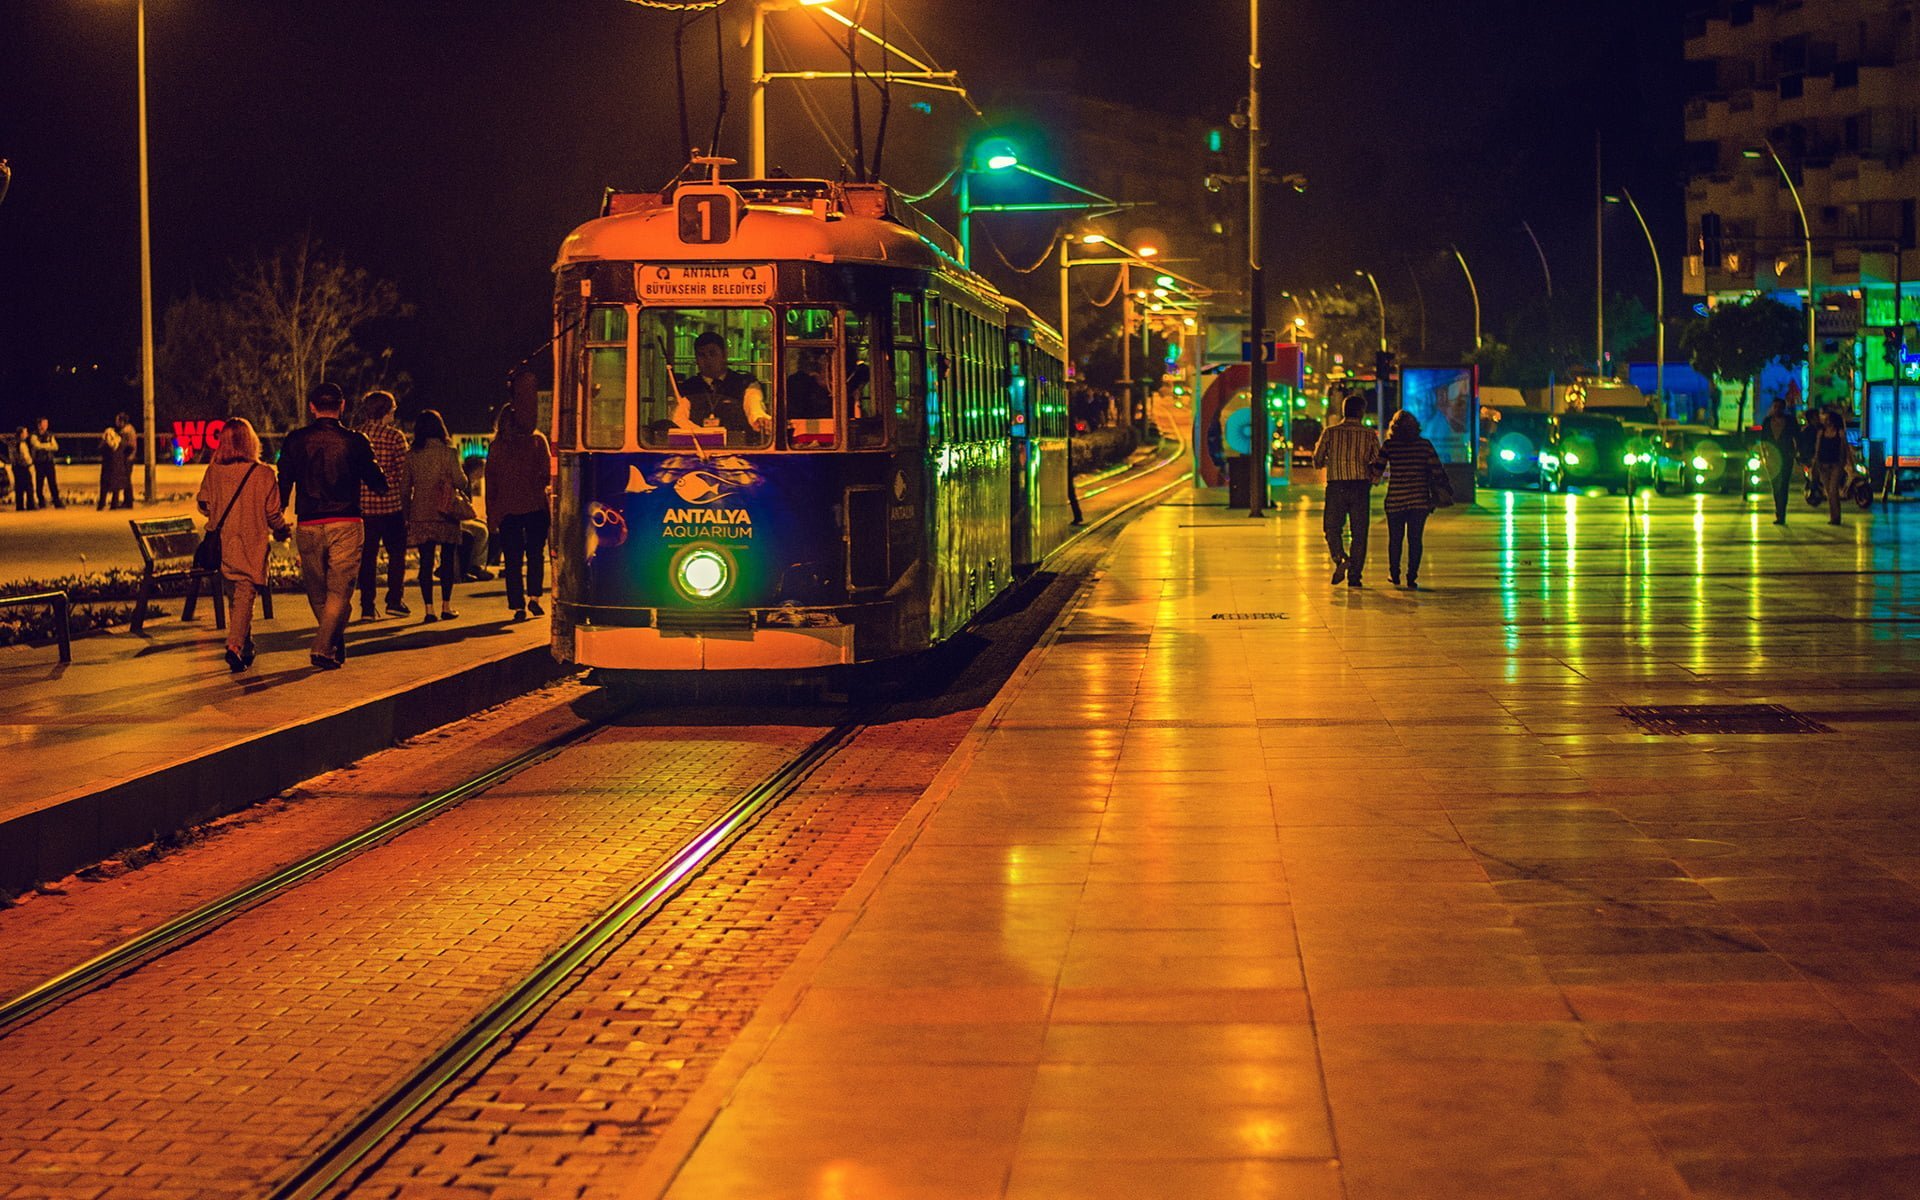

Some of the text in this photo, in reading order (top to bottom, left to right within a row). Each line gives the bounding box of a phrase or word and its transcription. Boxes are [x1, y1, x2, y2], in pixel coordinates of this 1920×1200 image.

[697, 201, 711, 241] 1
[683, 267, 729, 278] ANTALYA
[712, 281, 767, 294] BELEDİYESİ
[662, 508, 752, 525] ANTALYA
[662, 526, 753, 539] AQUARIUM
